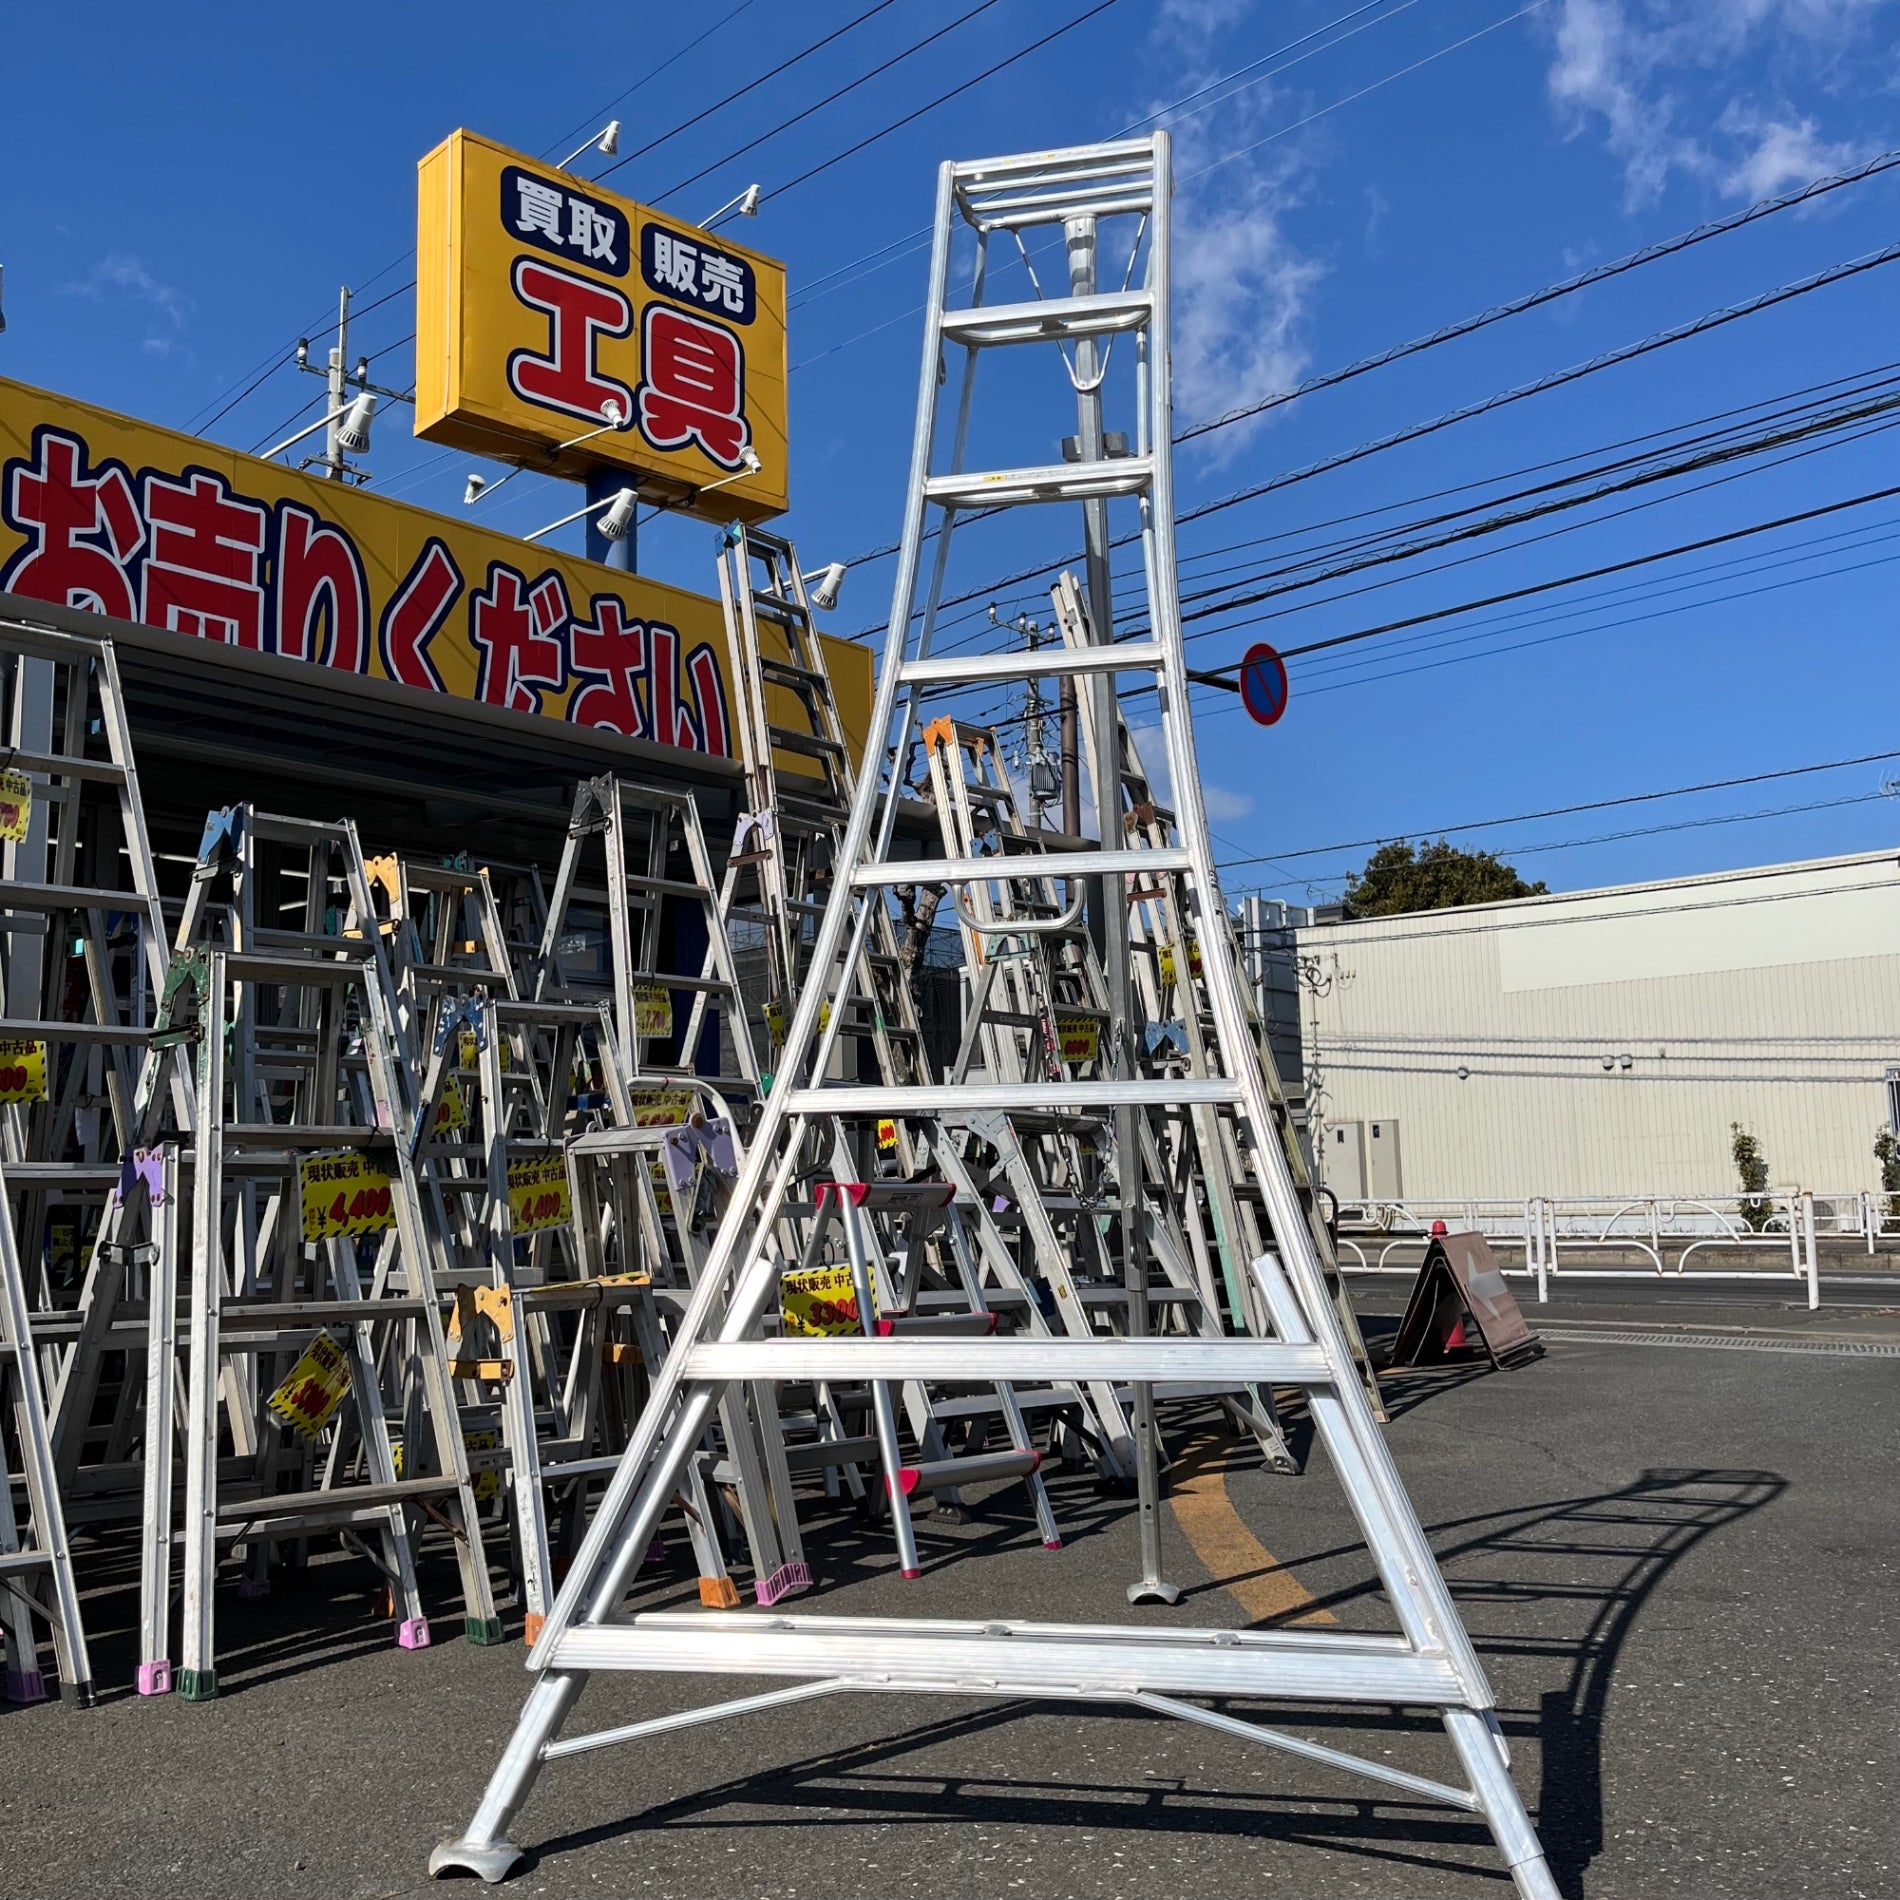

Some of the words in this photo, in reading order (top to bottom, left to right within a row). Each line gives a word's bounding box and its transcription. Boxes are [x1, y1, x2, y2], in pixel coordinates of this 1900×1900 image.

[515, 176, 618, 266] 買取
[653, 231, 745, 314] 販売
[508, 257, 754, 470] 工具
[3, 428, 731, 757] お売りください
[0, 1040, 38, 1056] 中古品
[307, 1160, 360, 1183] 現状販売
[785, 1273, 832, 1295] 現状販売
[834, 1271, 855, 1289] 中古
[809, 1296, 859, 1328] 3300
